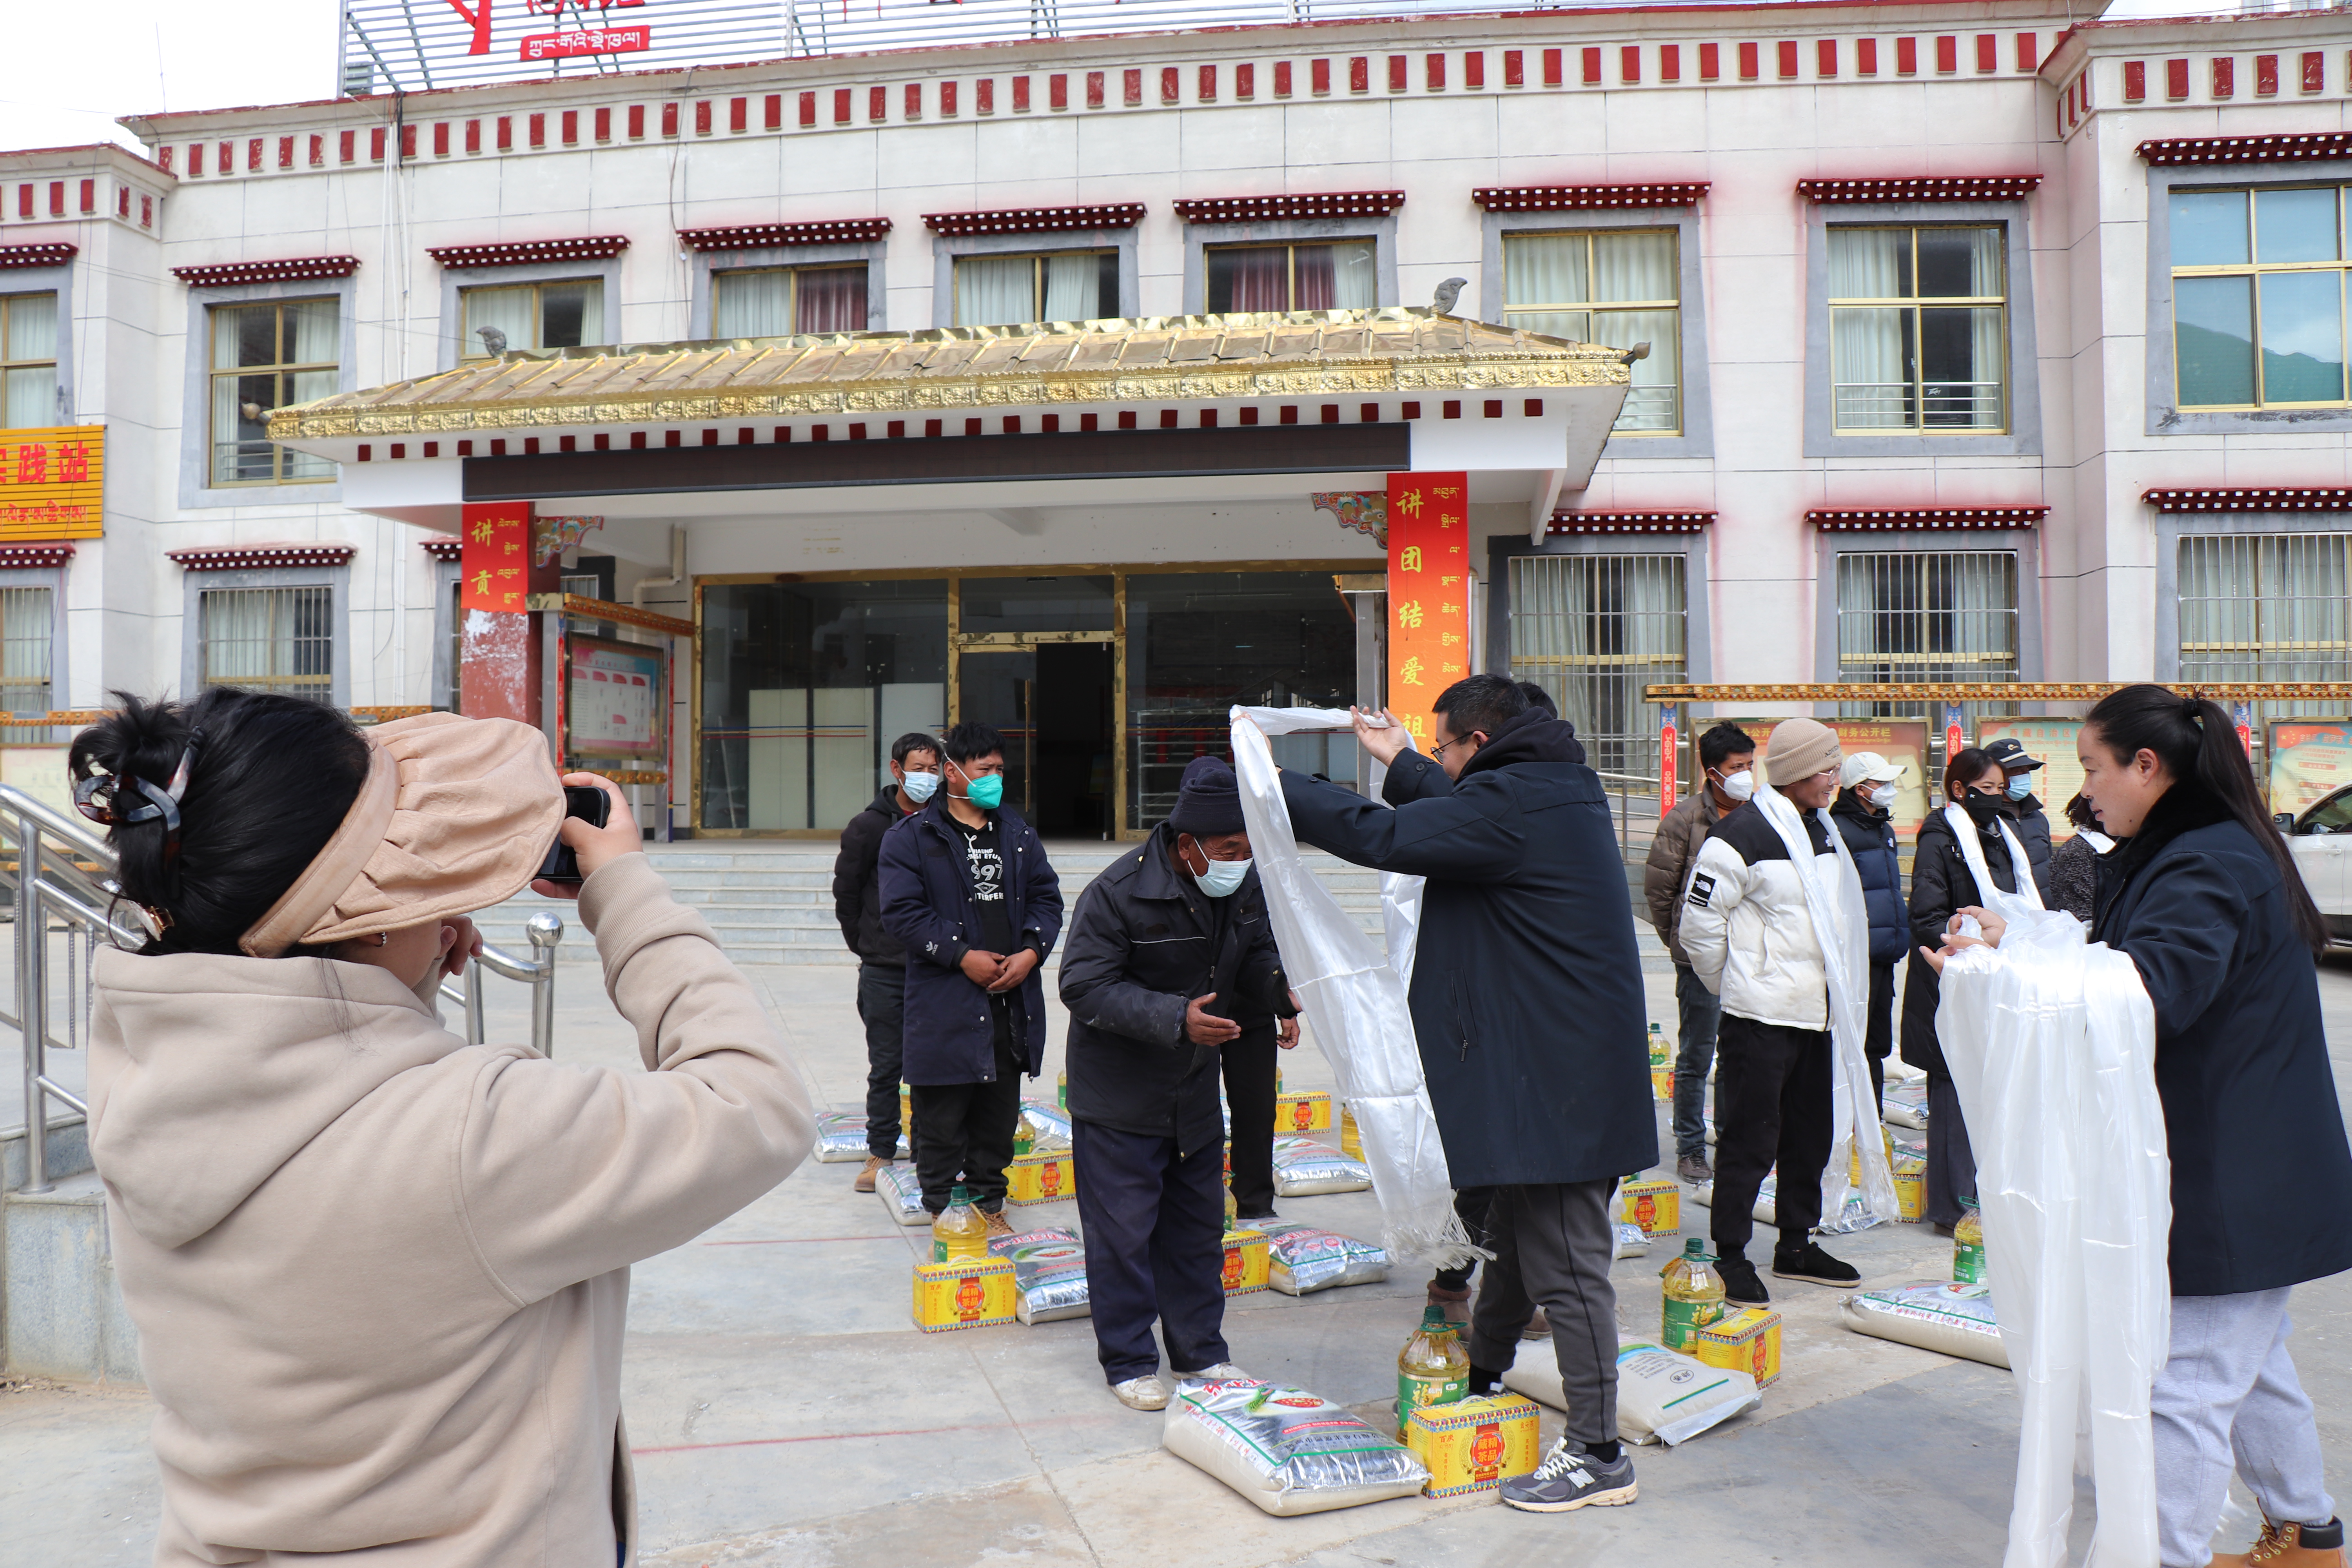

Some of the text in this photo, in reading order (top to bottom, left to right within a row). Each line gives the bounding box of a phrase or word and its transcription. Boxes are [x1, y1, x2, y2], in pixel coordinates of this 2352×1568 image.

[471, 518, 494, 595] 讲贡
[1396, 488, 1427, 737] 讲团结爱祖
[1839, 727, 1891, 737] 财务公开栏
[1566, 1468, 1596, 1489] N
